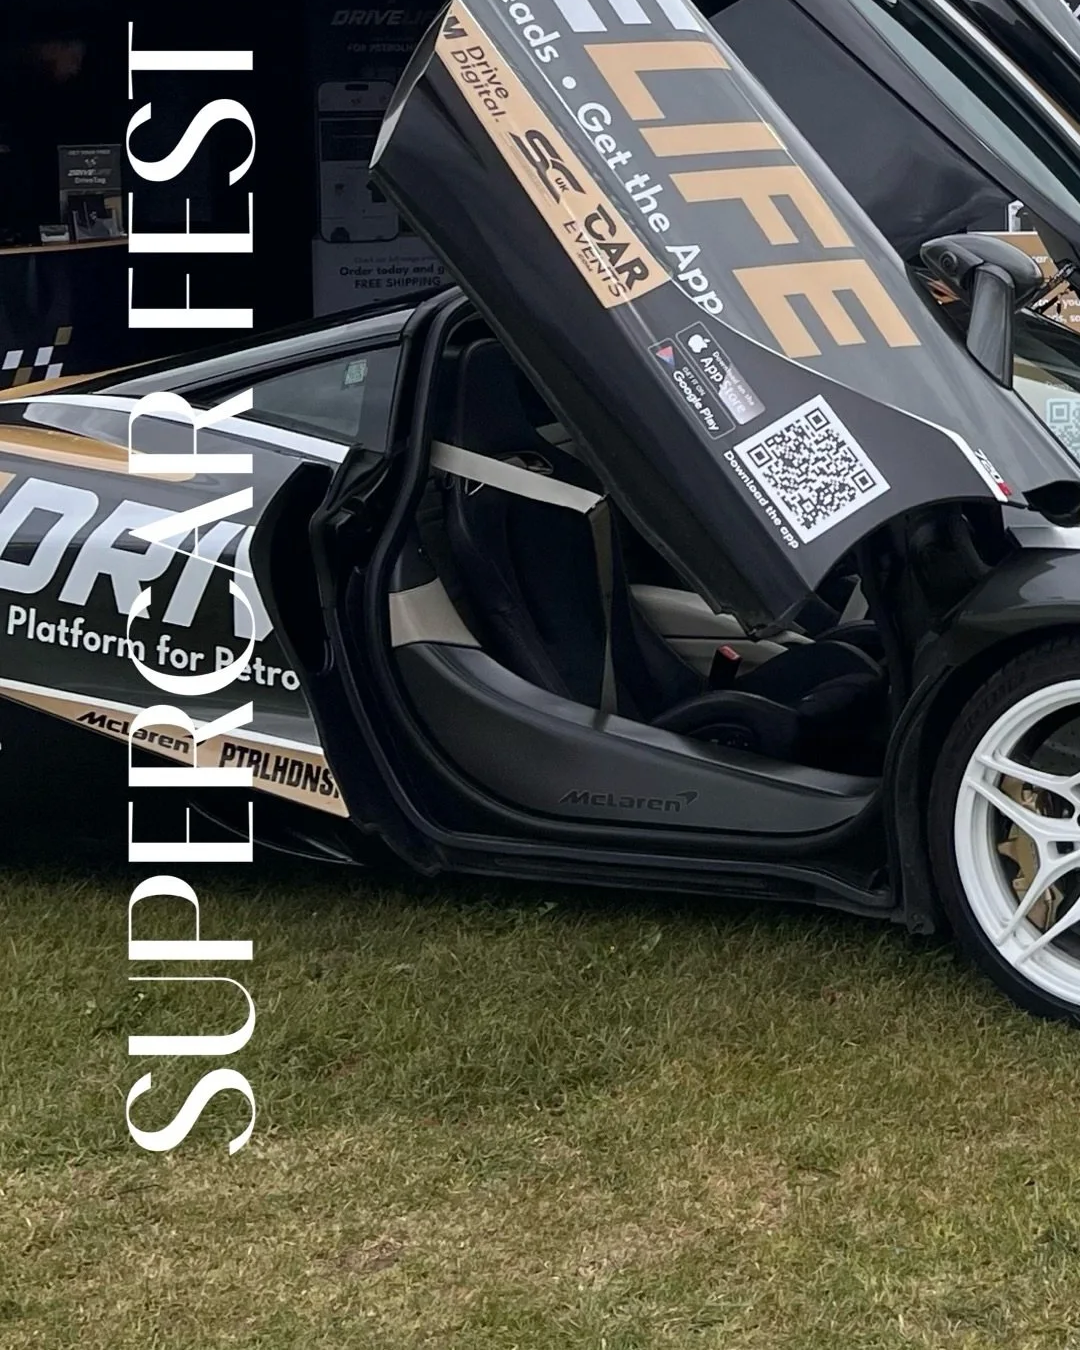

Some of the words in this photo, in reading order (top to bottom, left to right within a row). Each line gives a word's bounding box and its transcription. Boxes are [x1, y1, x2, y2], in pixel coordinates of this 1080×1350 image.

[466, 46, 509, 99] Drive
[554, 176, 570, 193] UK
[577, 102, 633, 170] Get
[624, 174, 670, 233] the
[665, 244, 724, 315] App
[339, 266, 373, 276] Order
[376, 264, 409, 278] today
[412, 264, 434, 274] and
[563, 219, 629, 298] EVENTS
[583, 203, 650, 291] CAR
[354, 279, 382, 289] FREE
[385, 276, 441, 288] SHIPPING
[673, 370, 702, 410] Google
[699, 407, 720, 431] Play
[700, 356, 724, 383] App
[718, 379, 747, 414] Store
[723, 450, 769, 507] Download
[765, 506, 782, 526] the
[780, 526, 799, 549] app
[7, 605, 145, 661] Platform
[156, 635, 205, 672] for
[76, 711, 190, 754] McLaren
[219, 741, 340, 799] PTRLHDNS
[558, 788, 682, 813] McLaren
